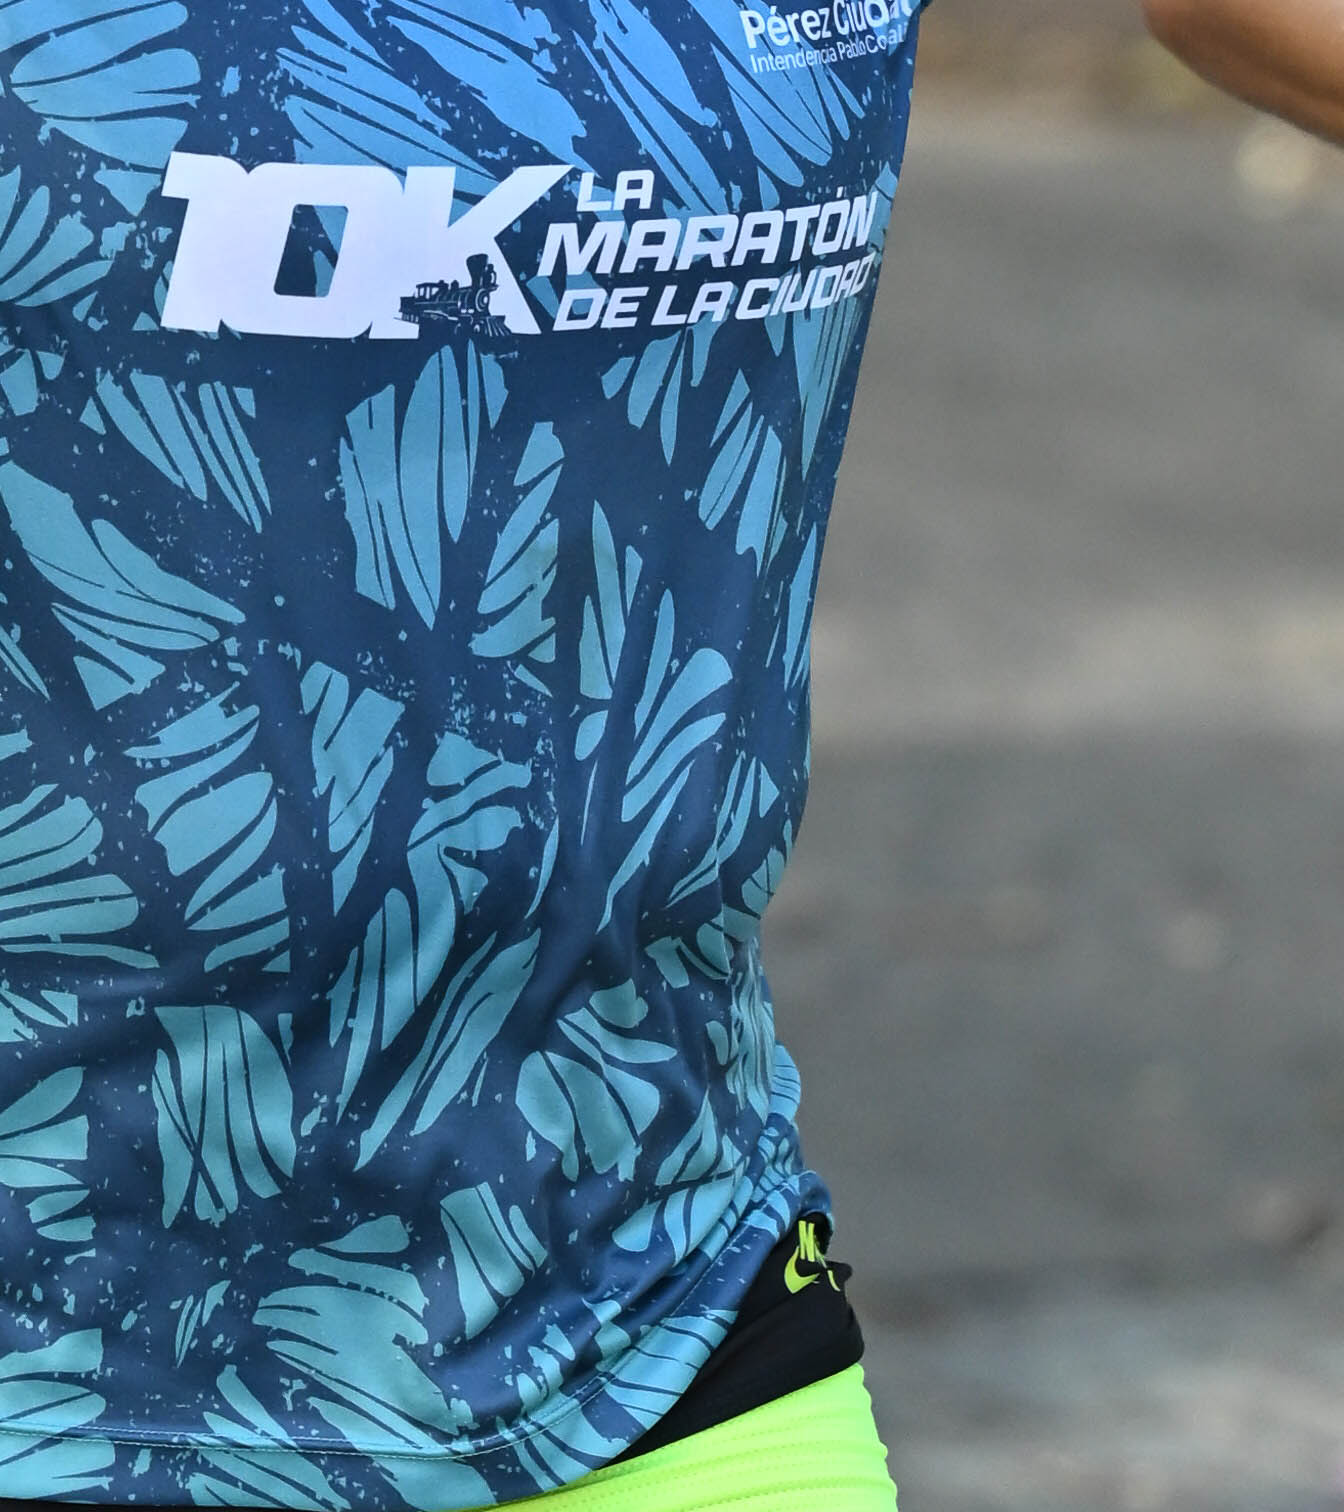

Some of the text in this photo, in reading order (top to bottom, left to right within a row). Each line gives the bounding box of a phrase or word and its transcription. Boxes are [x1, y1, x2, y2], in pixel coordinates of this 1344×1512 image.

[739, 5, 832, 49] Pérez
[750, 44, 837, 74] Intendencia
[576, 169, 655, 213] LA
[160, 151, 575, 340] 10K
[537, 185, 879, 277] MARATÓN
[552, 251, 877, 332] DE LA CIUDAD
